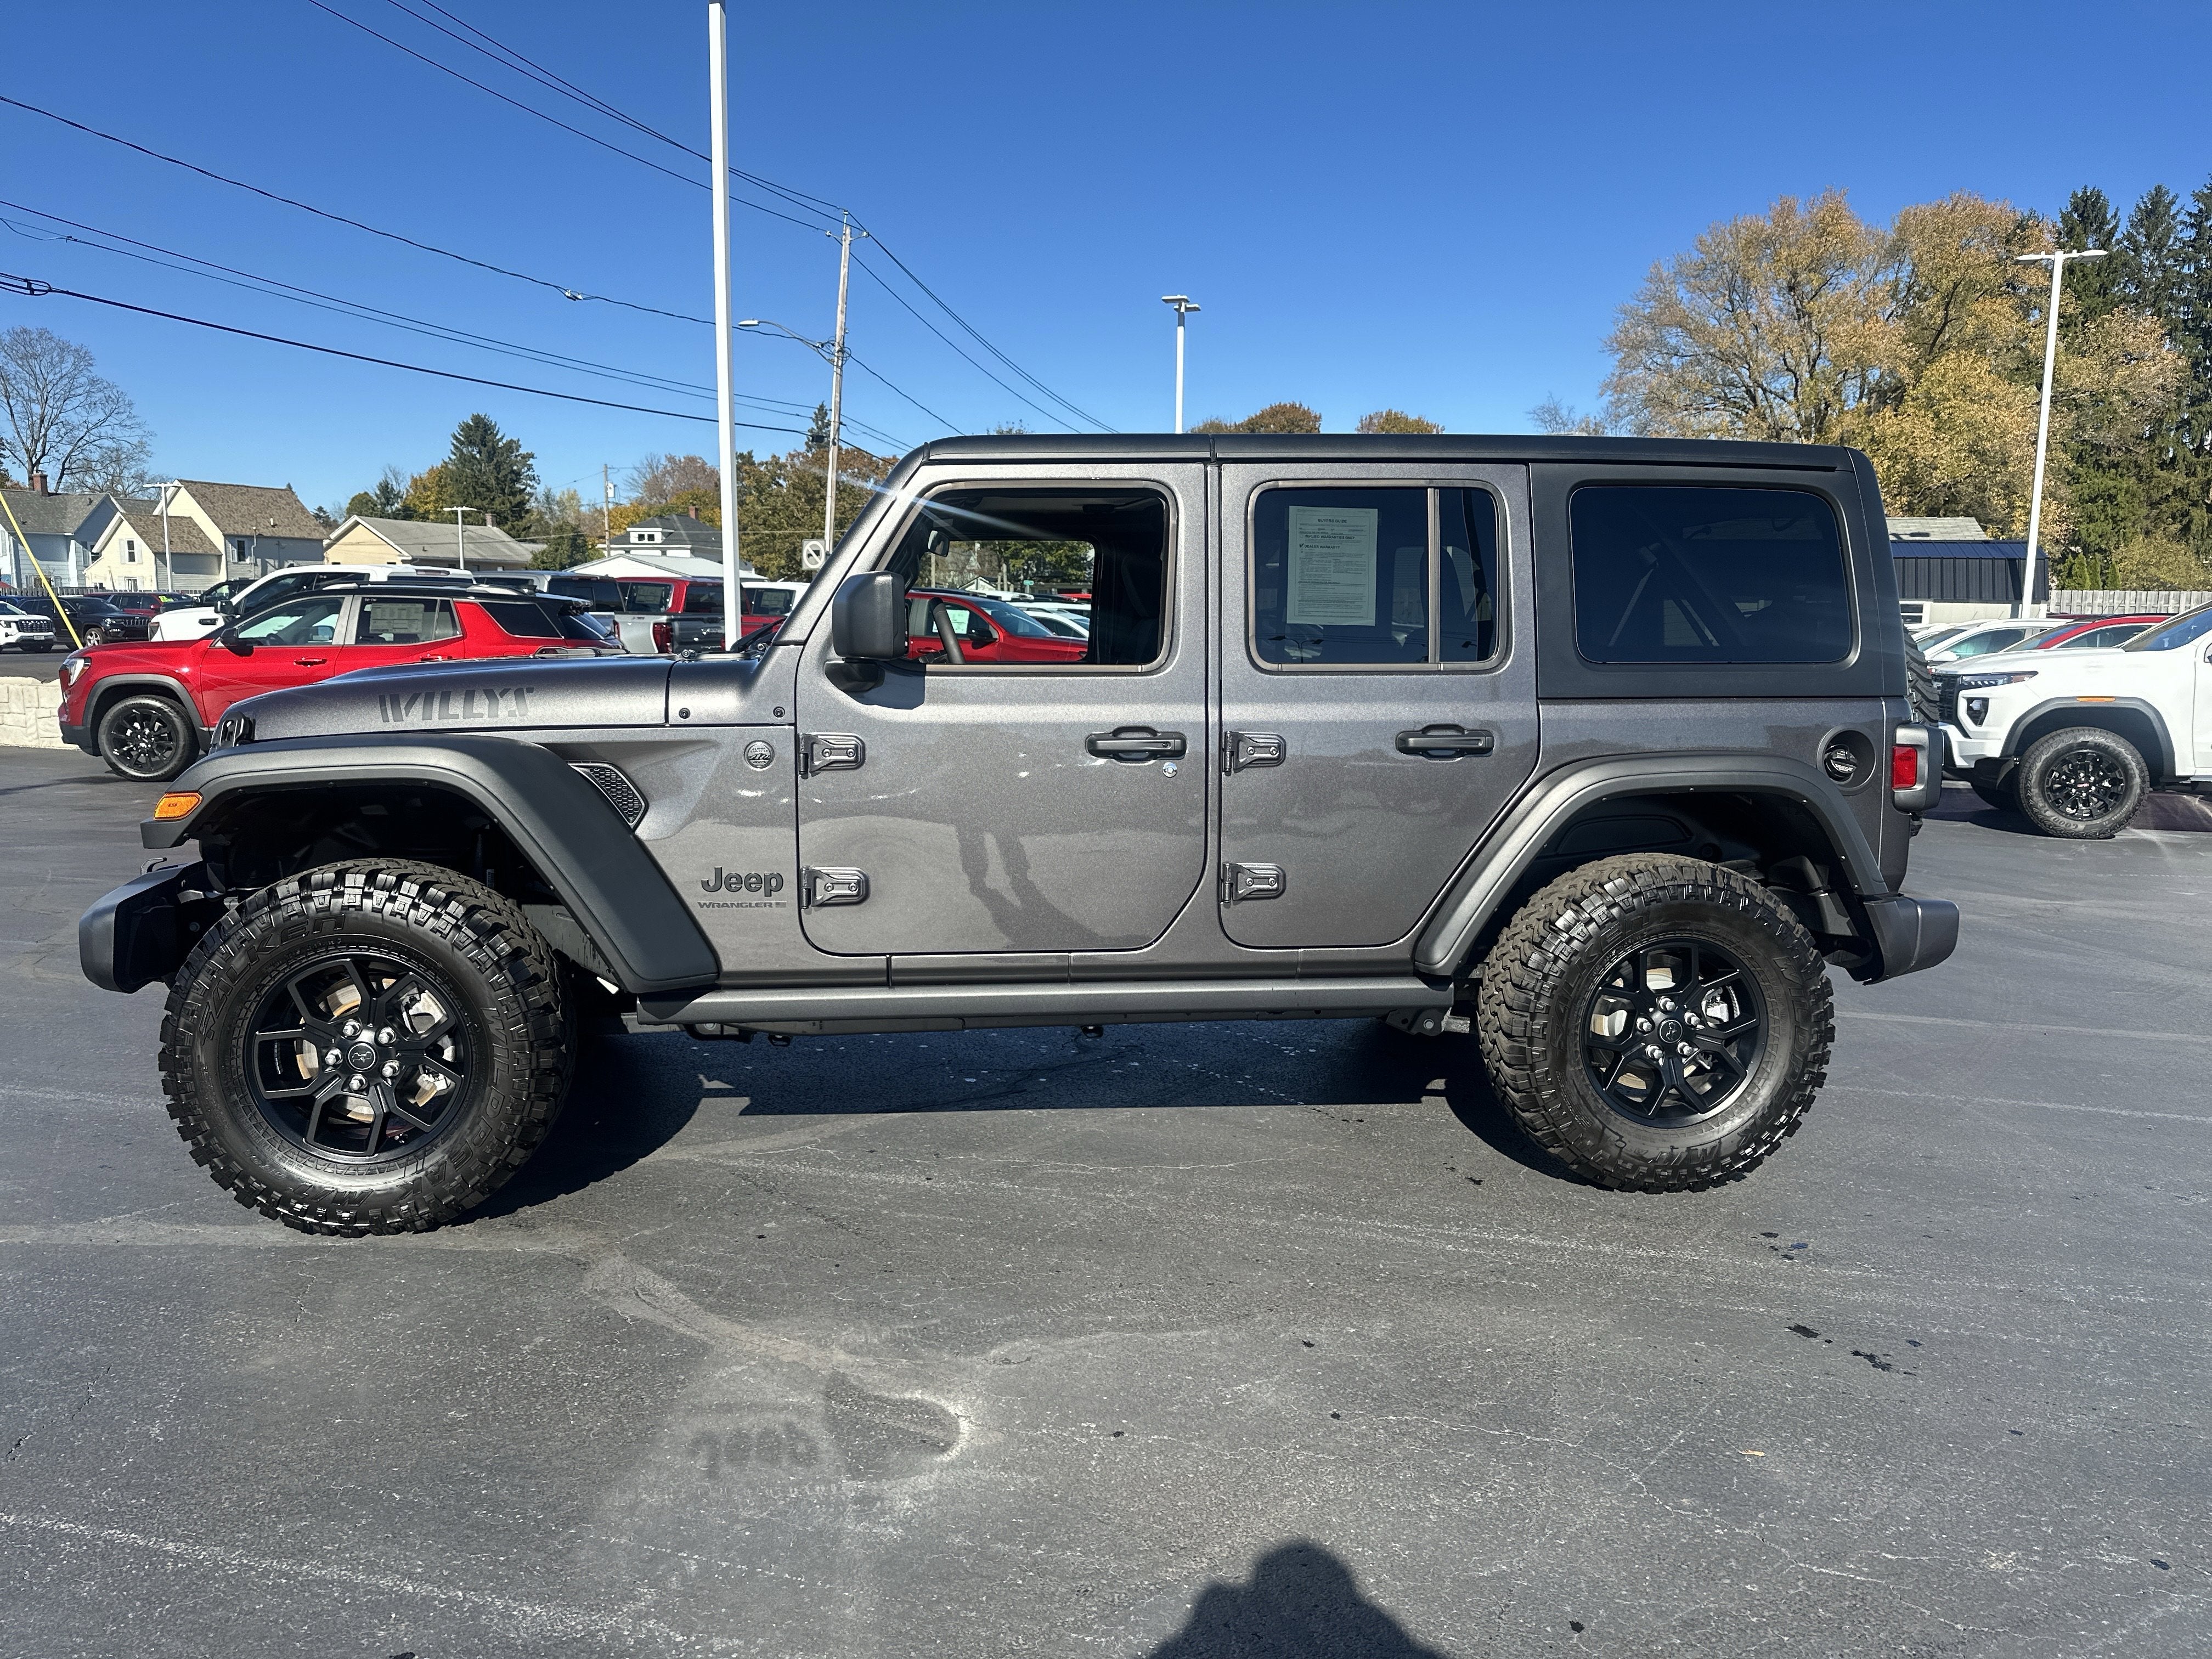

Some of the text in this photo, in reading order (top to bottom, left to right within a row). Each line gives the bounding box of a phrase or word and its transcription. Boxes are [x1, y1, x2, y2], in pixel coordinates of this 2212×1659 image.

[379, 687, 535, 723] WILLYS
[701, 866, 784, 897] Jeep
[395, 1007, 509, 1202] WILDPEAK
